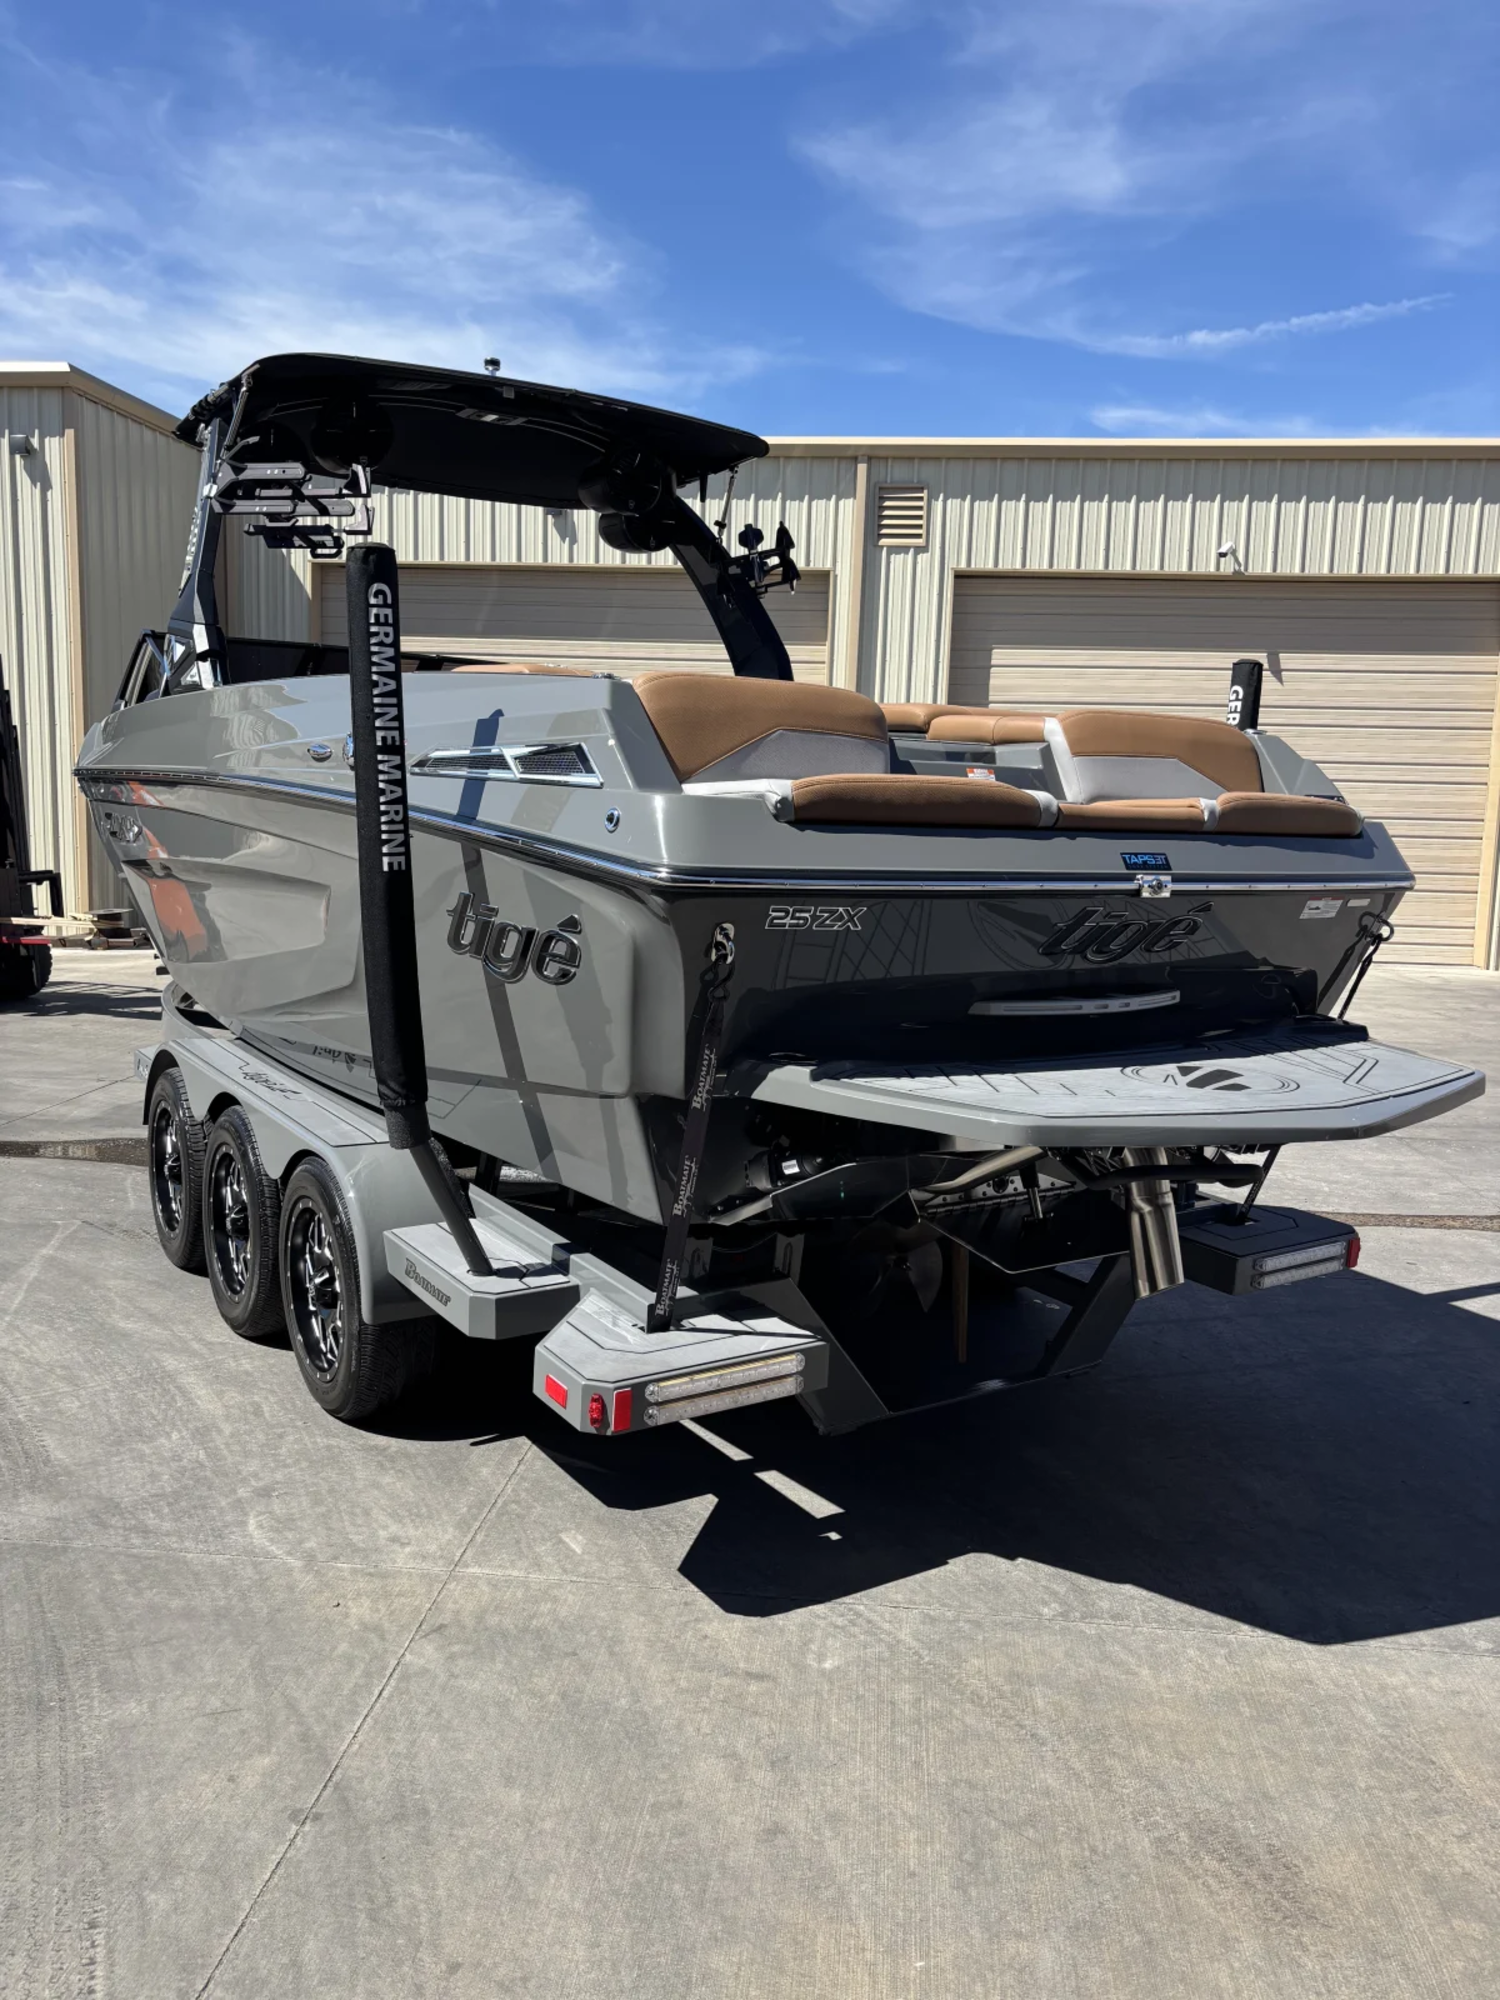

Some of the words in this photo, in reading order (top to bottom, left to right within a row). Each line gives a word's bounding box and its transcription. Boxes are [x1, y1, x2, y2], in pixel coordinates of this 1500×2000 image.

[367, 582, 400, 746] GERMAINE
[376, 754, 406, 872] MARINE
[446, 891, 583, 986] tigé
